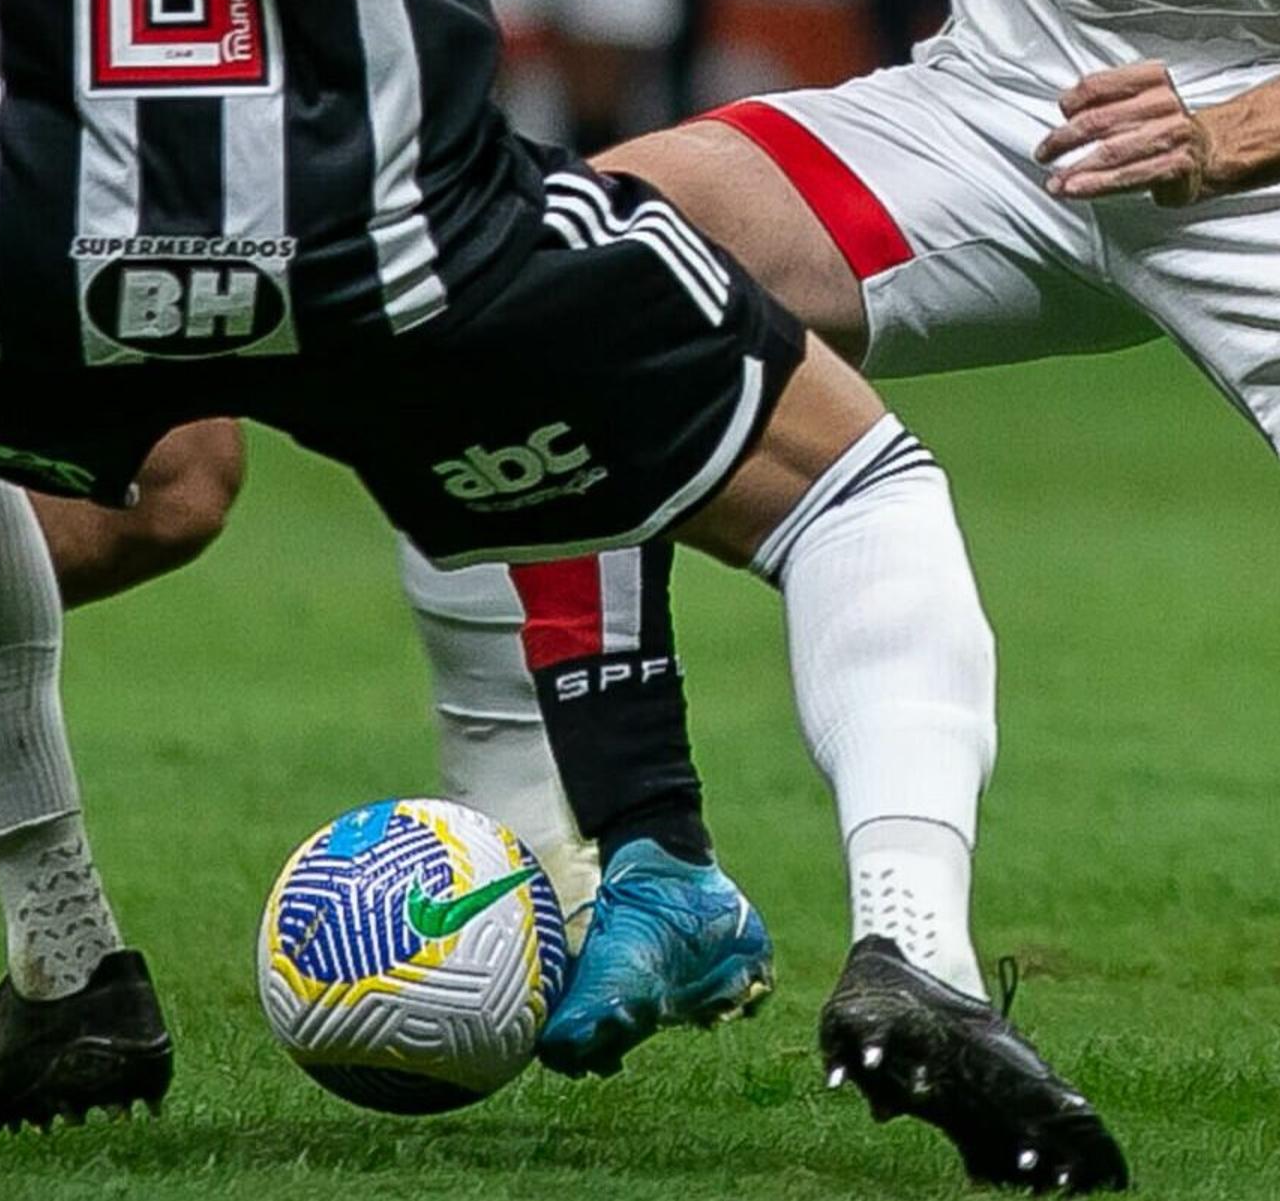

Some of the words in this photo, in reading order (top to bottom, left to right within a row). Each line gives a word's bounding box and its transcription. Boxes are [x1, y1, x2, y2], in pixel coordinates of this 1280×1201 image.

[74, 237, 295, 258] SUPERMERCADOS
[118, 269, 258, 338] BH
[432, 421, 591, 498] abc
